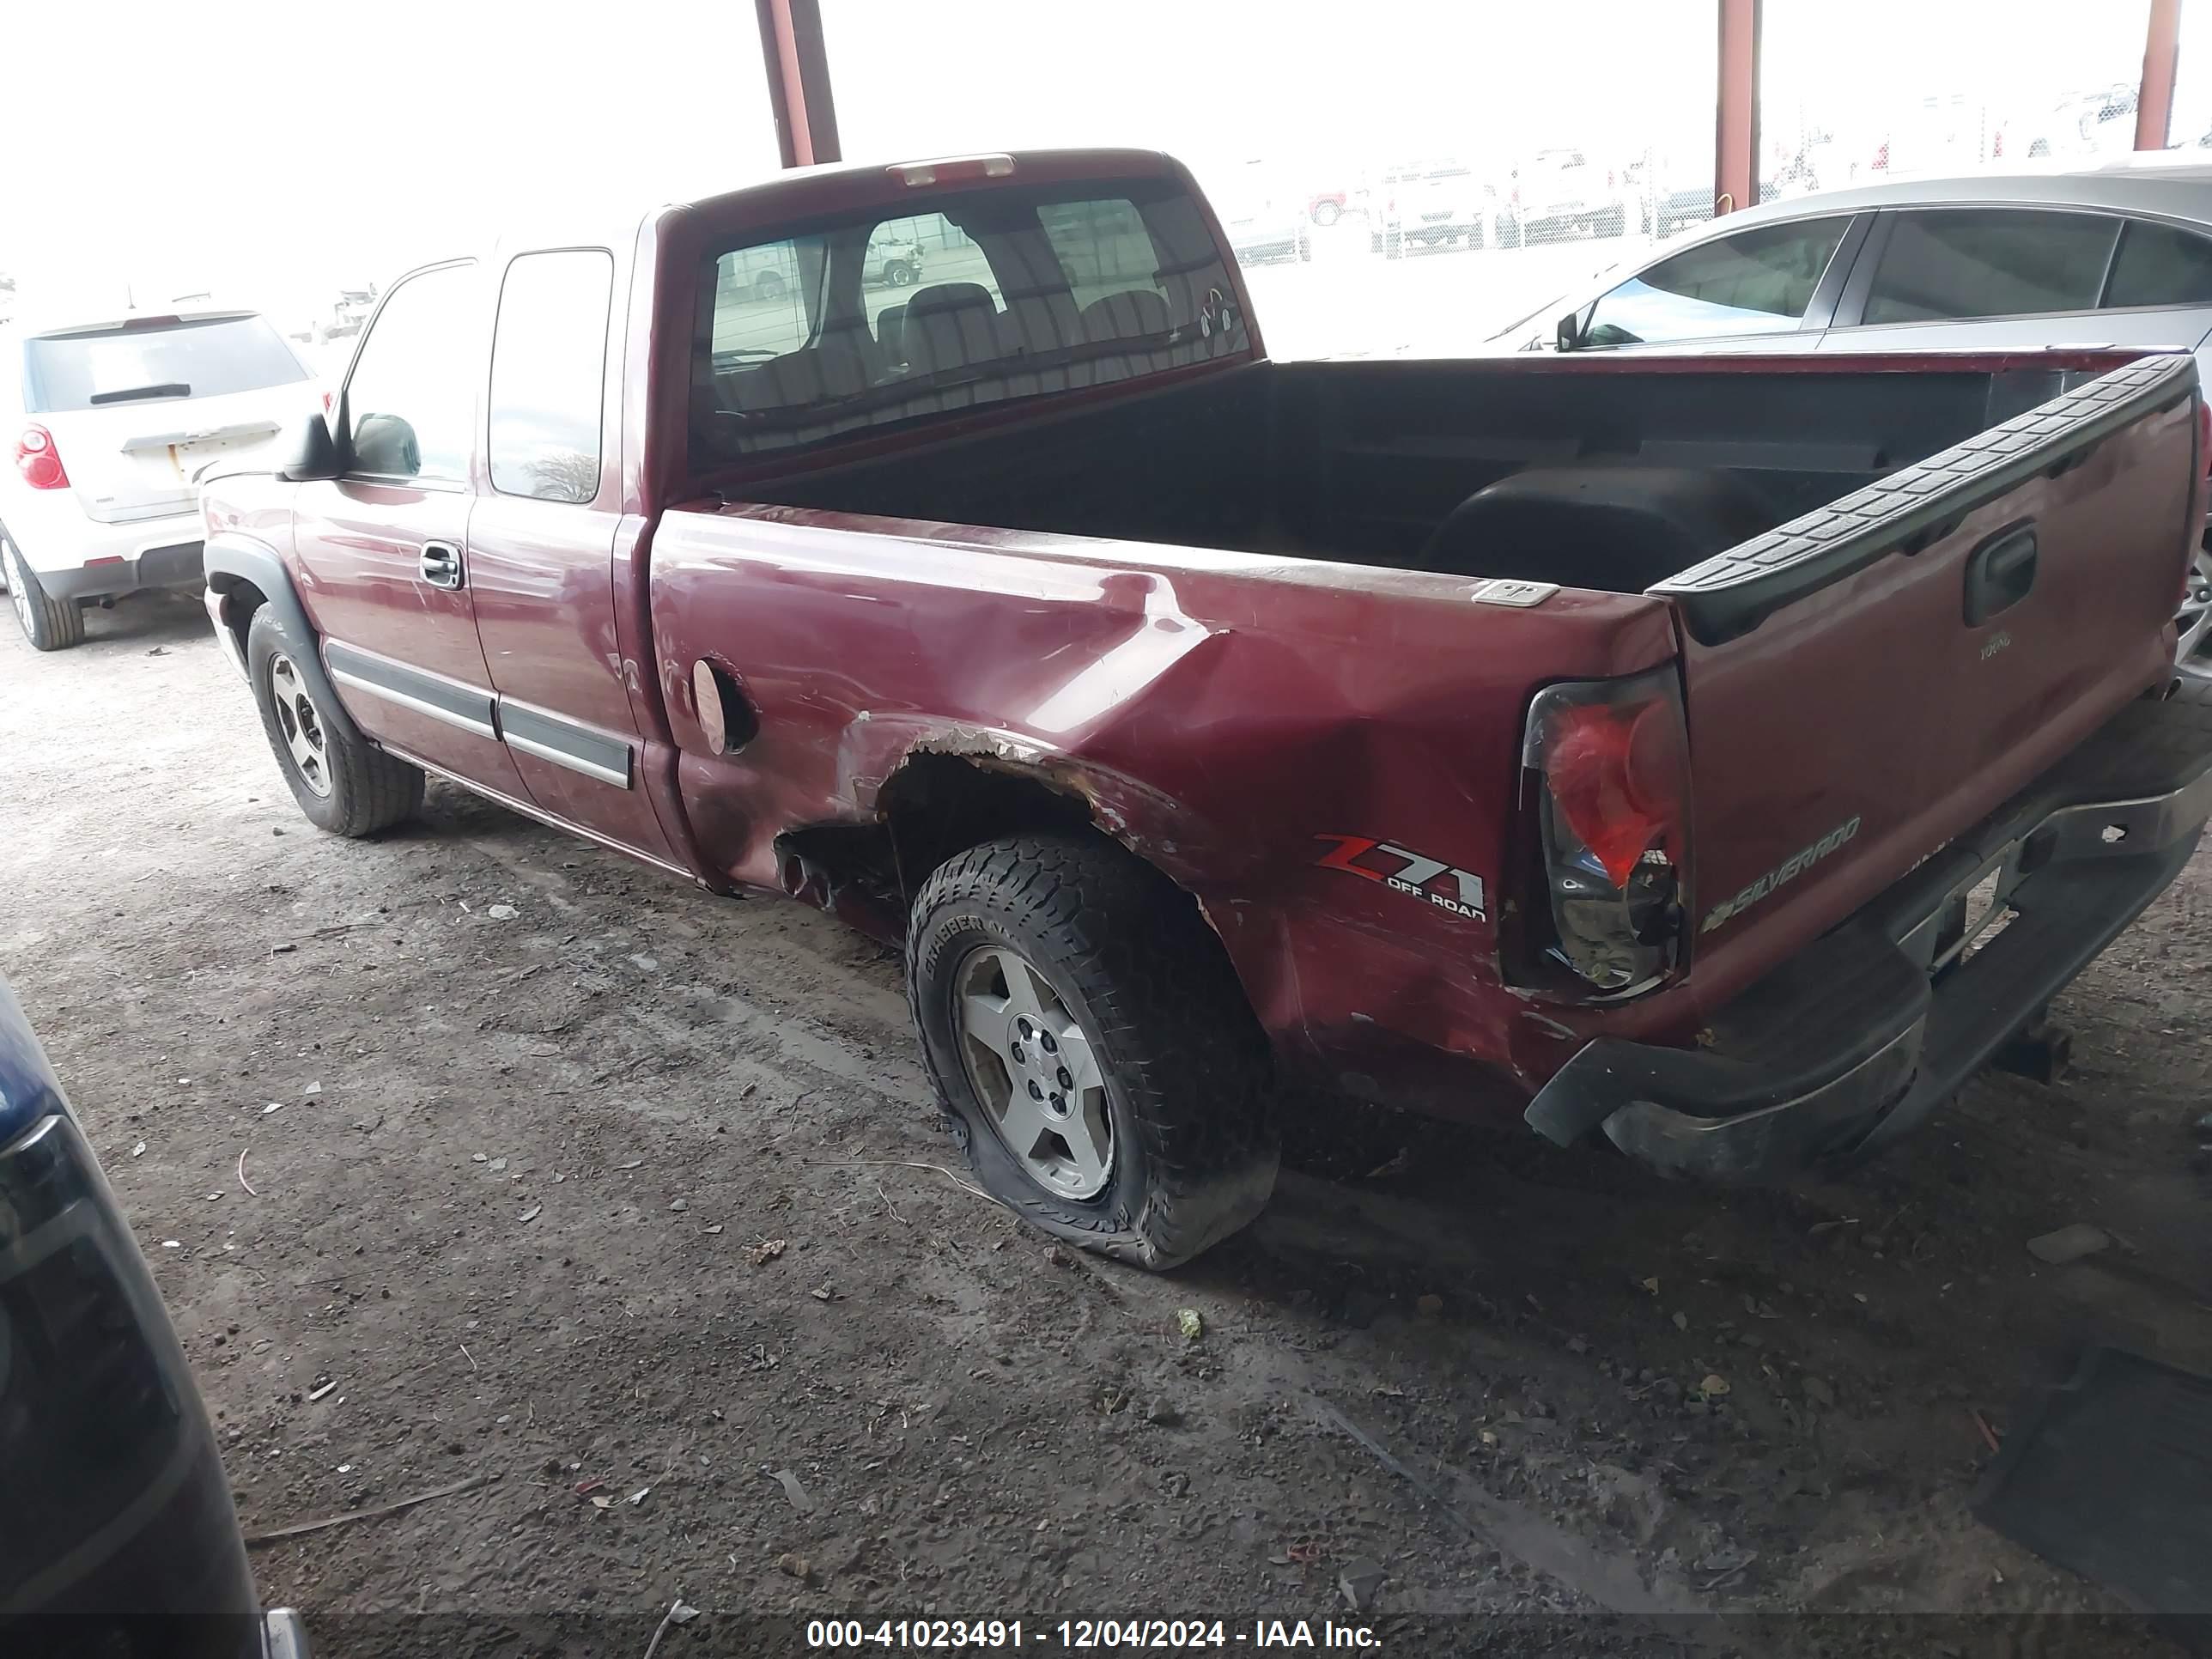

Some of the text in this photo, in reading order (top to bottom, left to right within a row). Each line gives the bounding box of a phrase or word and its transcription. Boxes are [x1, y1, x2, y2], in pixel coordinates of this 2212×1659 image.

[1313, 832, 1485, 910] Z71
[1387, 877, 1486, 923] OFF ROAD
[1731, 816, 1861, 915] SILVERADO
[925, 915, 985, 981] GRABBER
